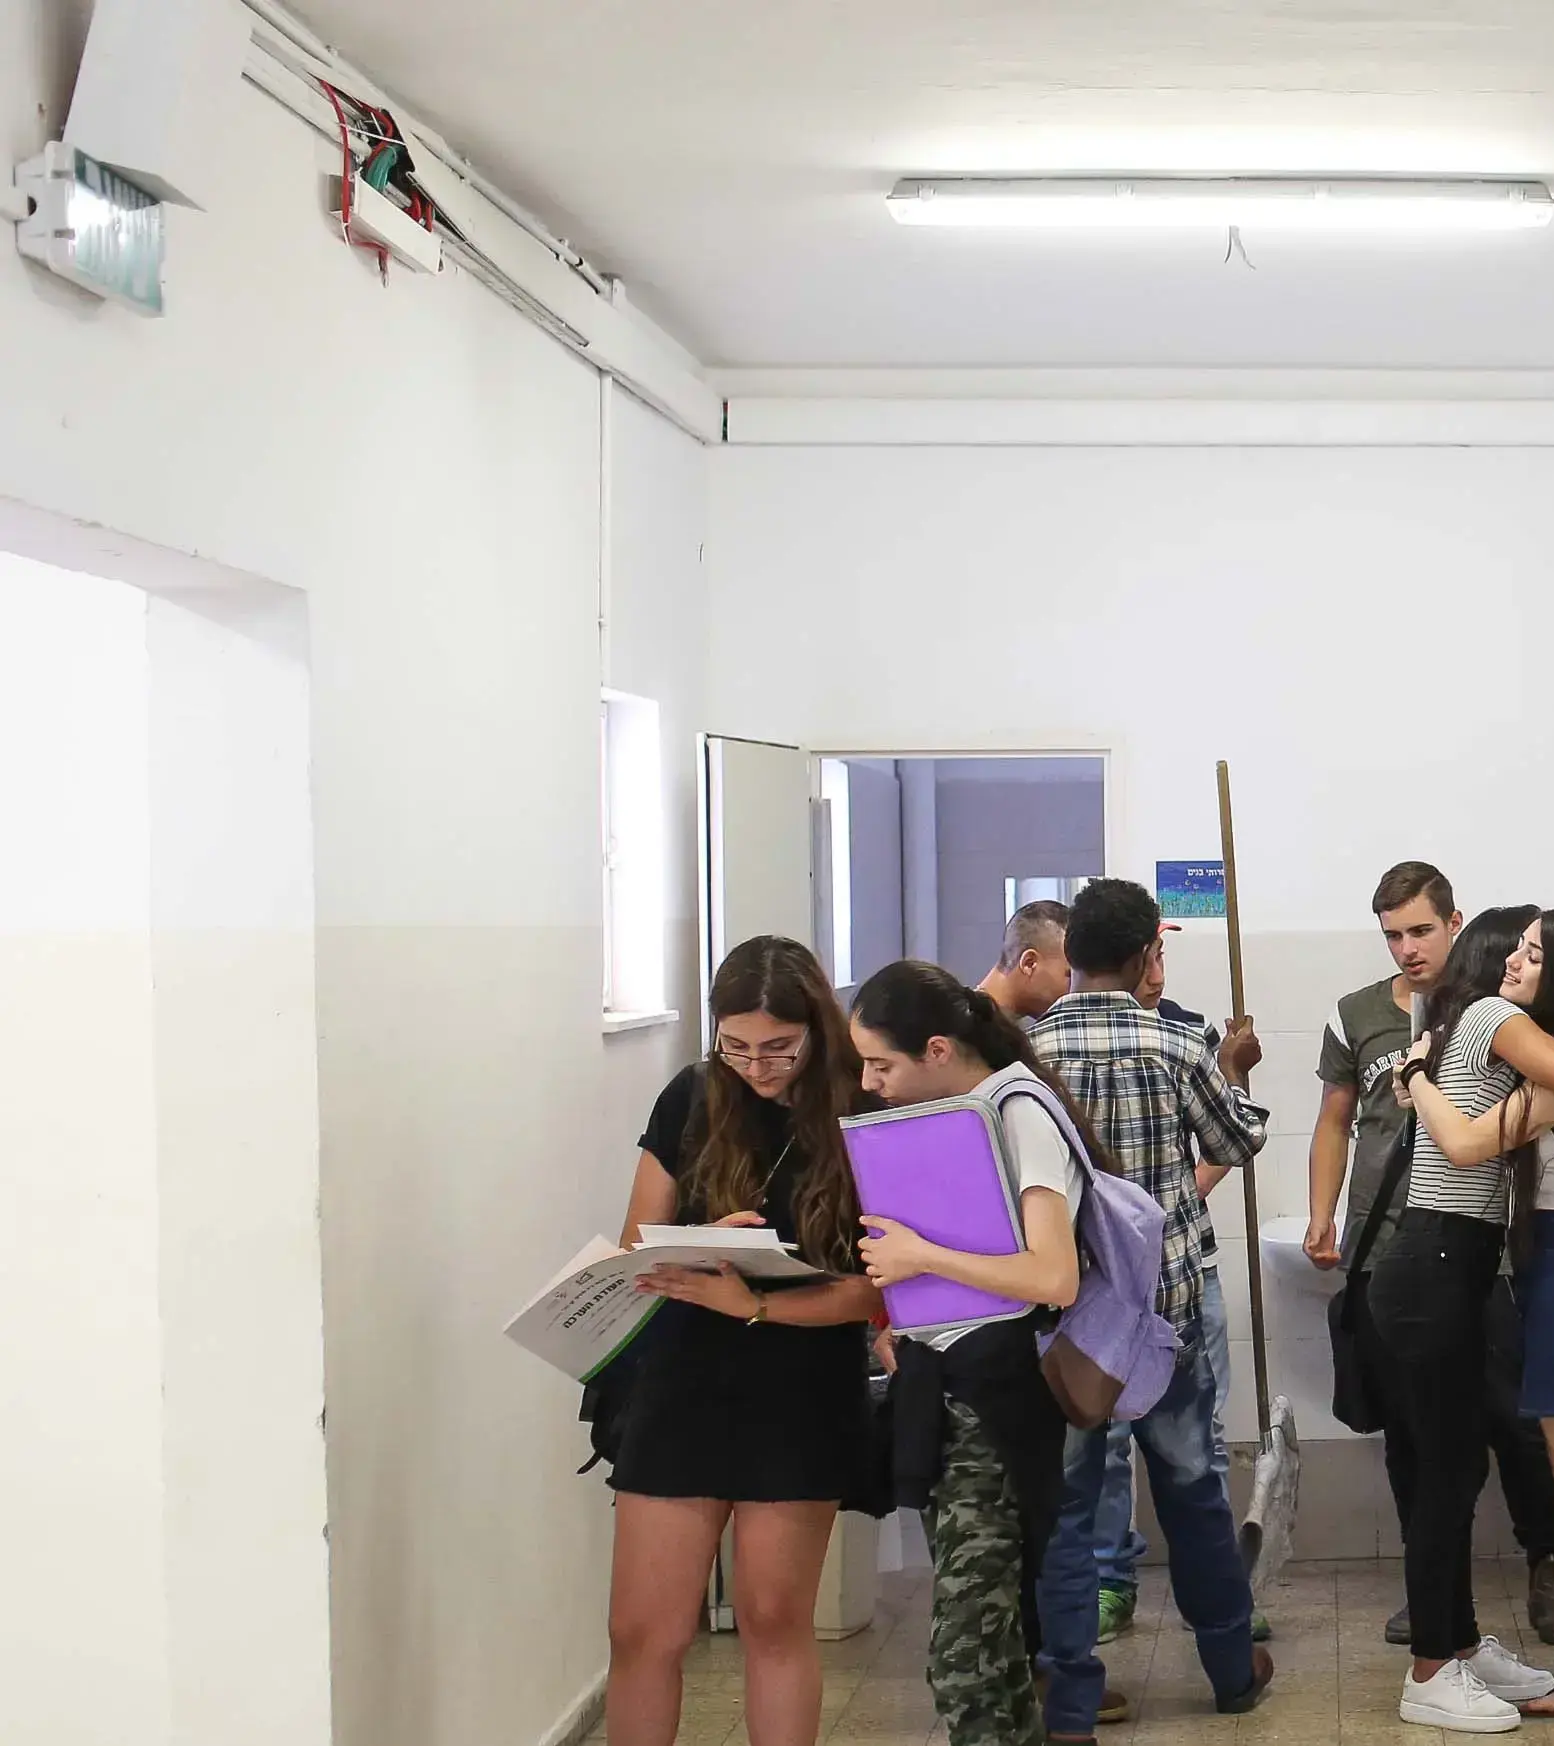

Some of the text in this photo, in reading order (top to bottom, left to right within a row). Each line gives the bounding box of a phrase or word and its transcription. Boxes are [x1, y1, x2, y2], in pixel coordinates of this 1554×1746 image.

[1187, 868, 1204, 877] בנים
[593, 1278, 626, 1302] תעודת
[563, 1301, 594, 1329] הערכה
